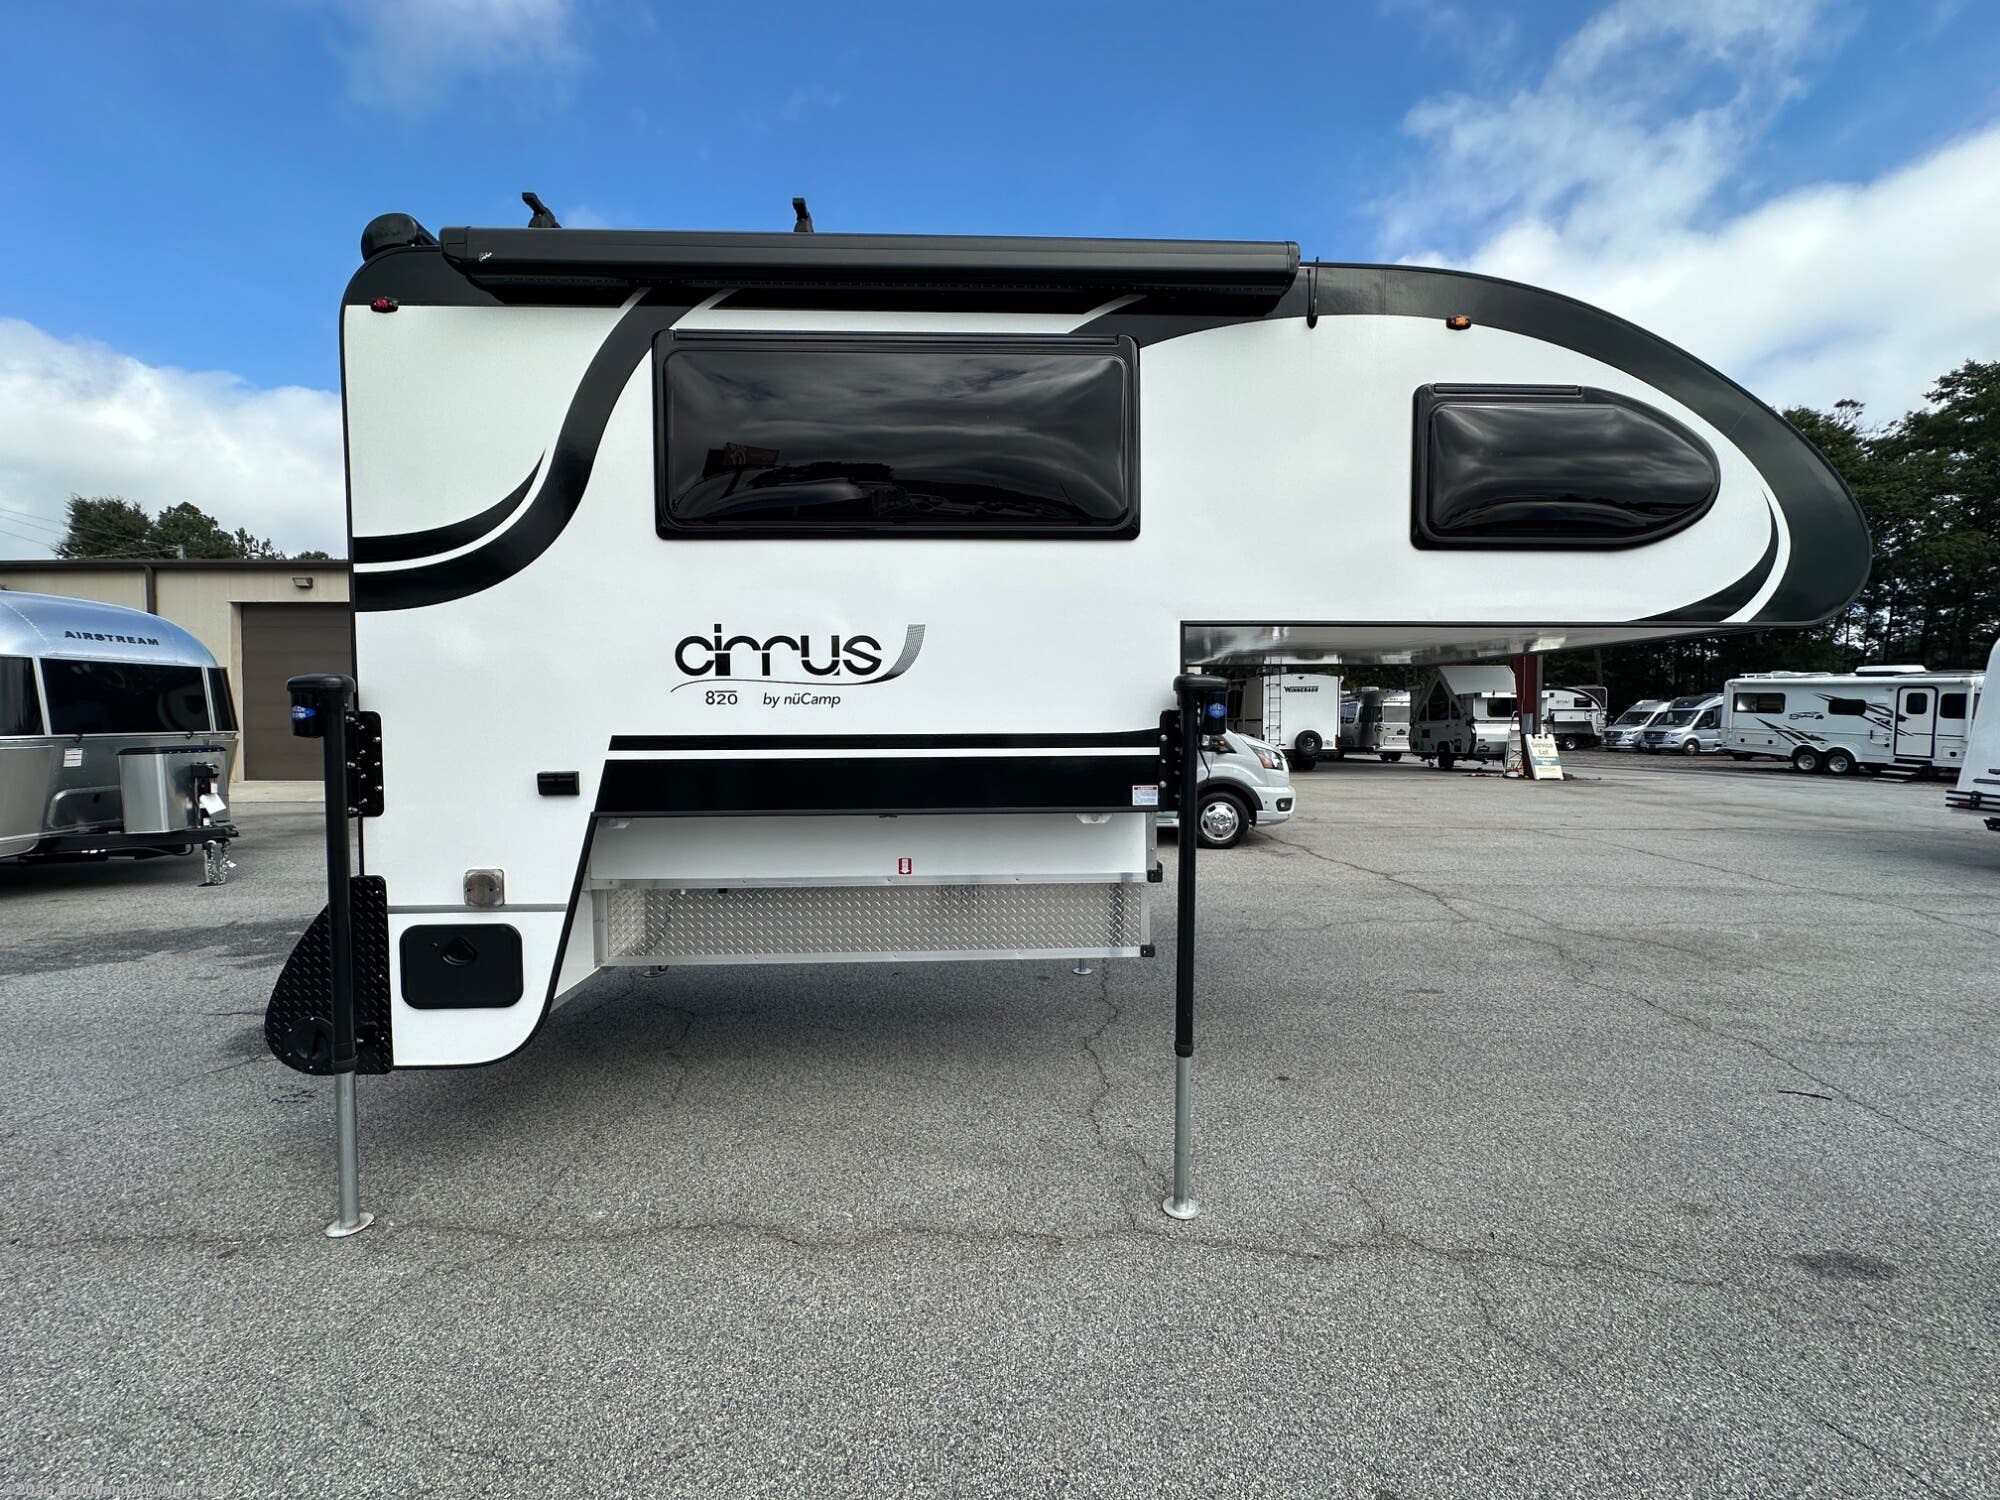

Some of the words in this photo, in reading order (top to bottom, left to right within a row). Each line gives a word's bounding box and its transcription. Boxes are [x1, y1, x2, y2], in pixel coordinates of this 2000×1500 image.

[64, 630, 160, 646] AIRSTREAM
[675, 623, 882, 676] cirrus
[705, 690, 738, 705] 820
[762, 692, 780, 708] by
[783, 692, 841, 708] nüCamp
